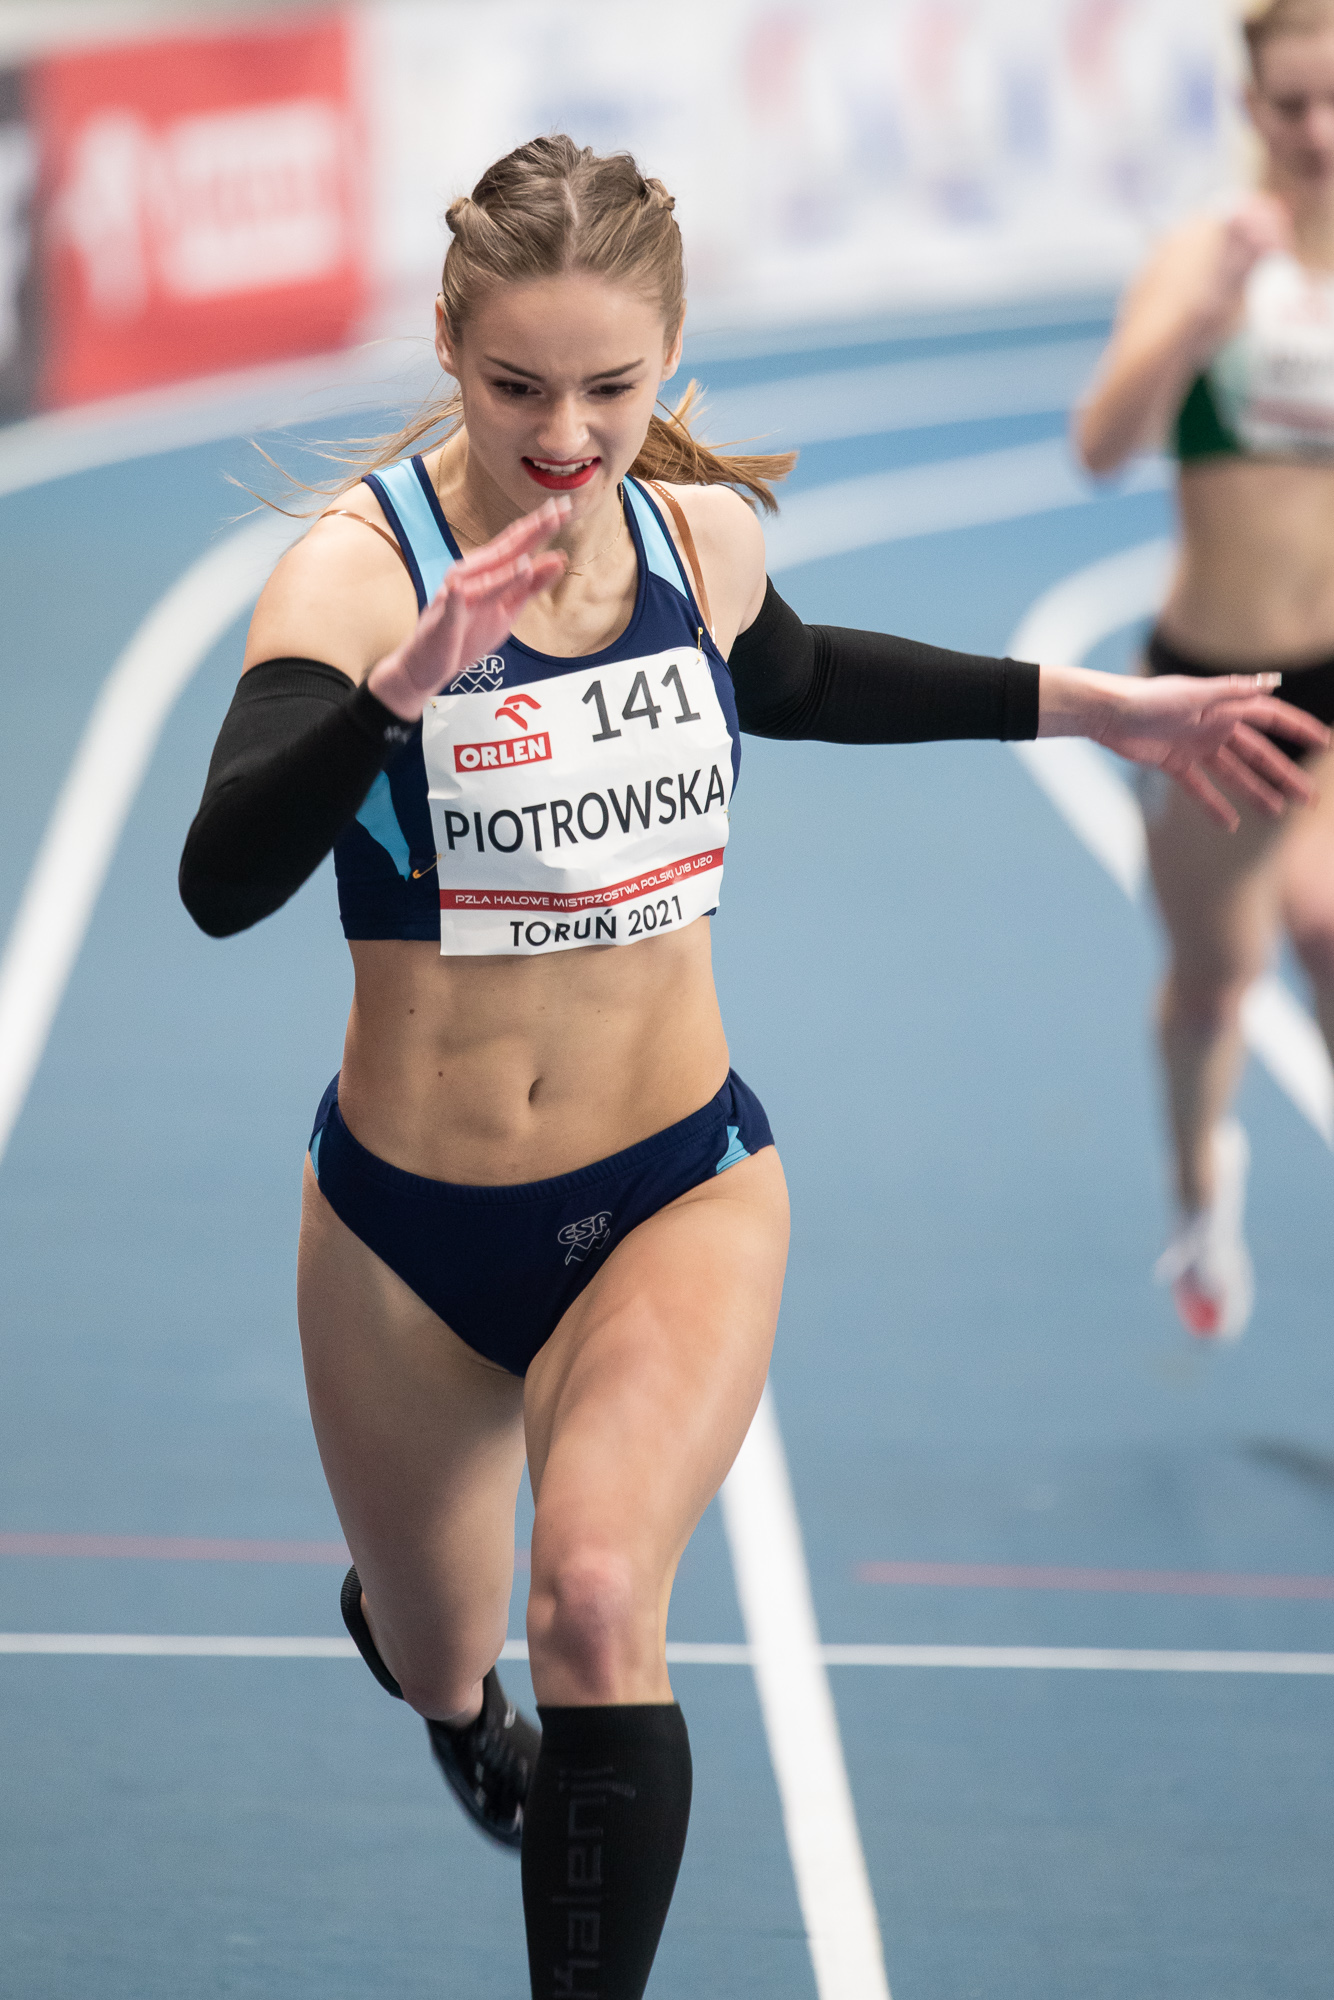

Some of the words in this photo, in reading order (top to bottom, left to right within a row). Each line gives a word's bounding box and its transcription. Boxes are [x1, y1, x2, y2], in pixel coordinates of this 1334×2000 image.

[581, 663, 702, 743] 141
[459, 736, 547, 769] ORLEN
[443, 763, 726, 854] PIOTROWSKA
[455, 895, 491, 904] PZLA
[494, 896, 550, 906] HALOWE
[553, 883, 640, 908] MISTRZOSTWA
[640, 869, 675, 890] POLSKI
[675, 864, 692, 877] U18
[693, 854, 713, 869] U20
[510, 908, 617, 947] TORUŃ
[628, 895, 683, 936] 2021
